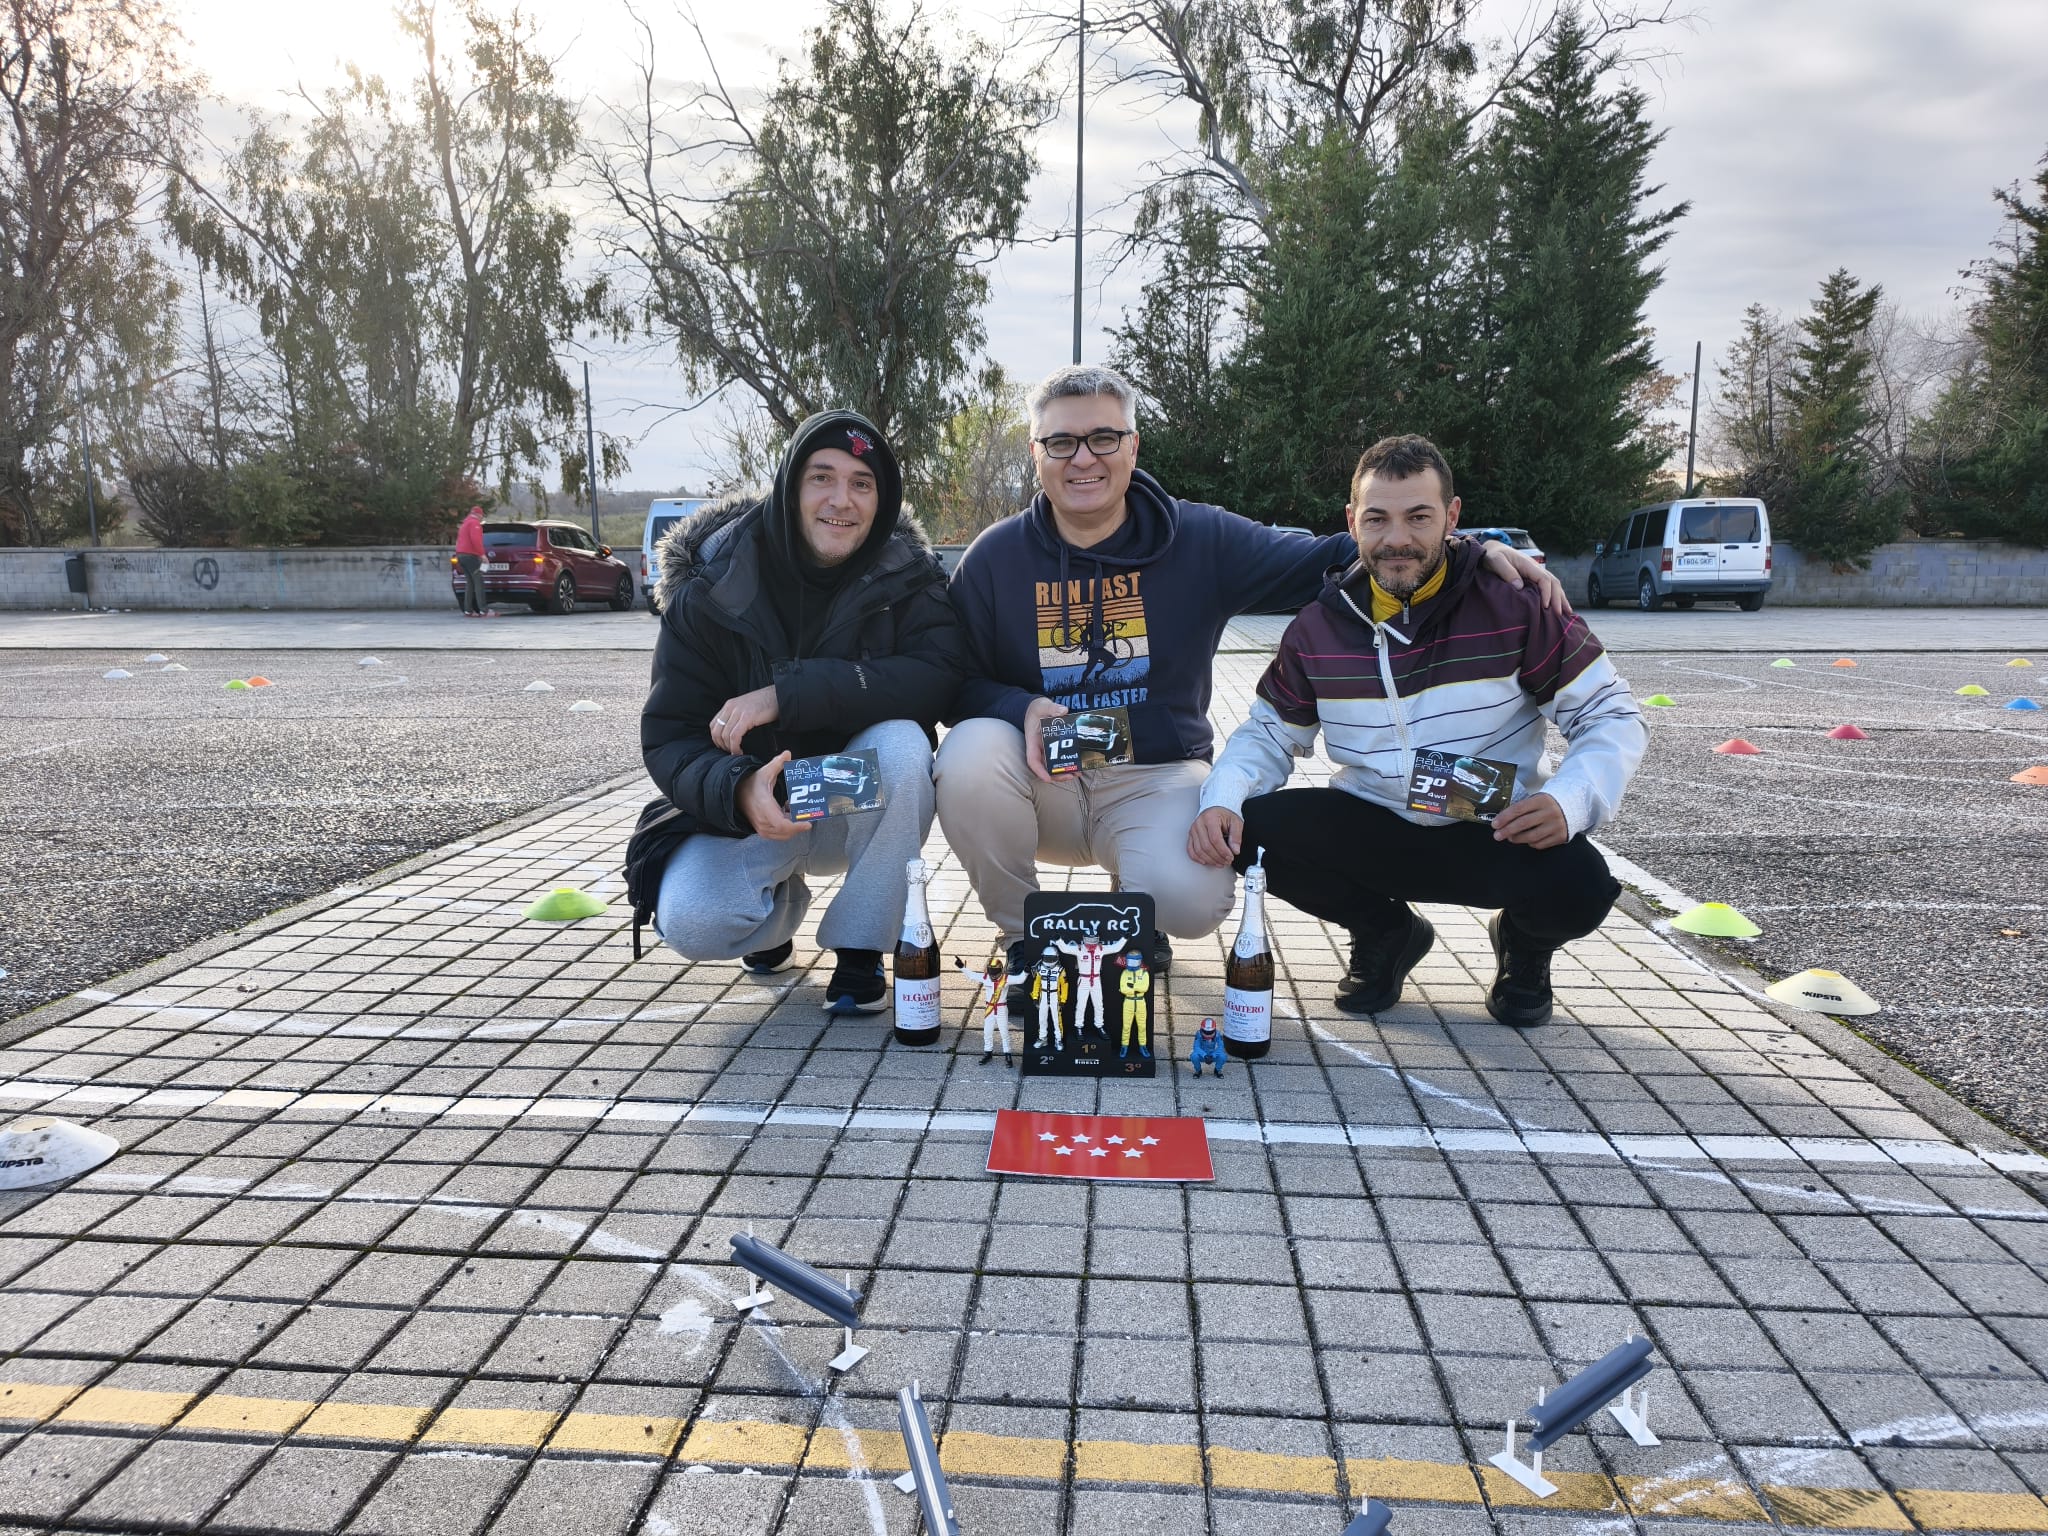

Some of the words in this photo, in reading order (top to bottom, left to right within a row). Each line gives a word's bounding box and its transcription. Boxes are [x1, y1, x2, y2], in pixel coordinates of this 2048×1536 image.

[1035, 580, 1081, 607] RUN
[1052, 692, 1089, 710] EDAL
[1094, 687, 1149, 708] FASTER
[1043, 722, 1075, 733] RALLY
[1415, 756, 1454, 768] RALLY
[785, 764, 821, 776] RALLY
[1427, 792, 1447, 800] 4wd
[1043, 919, 1100, 931] RALLY
[1107, 919, 1131, 931] RC
[1804, 991, 1843, 1002] KIPSTA
[1227, 1000, 1265, 1013] GAITERO
